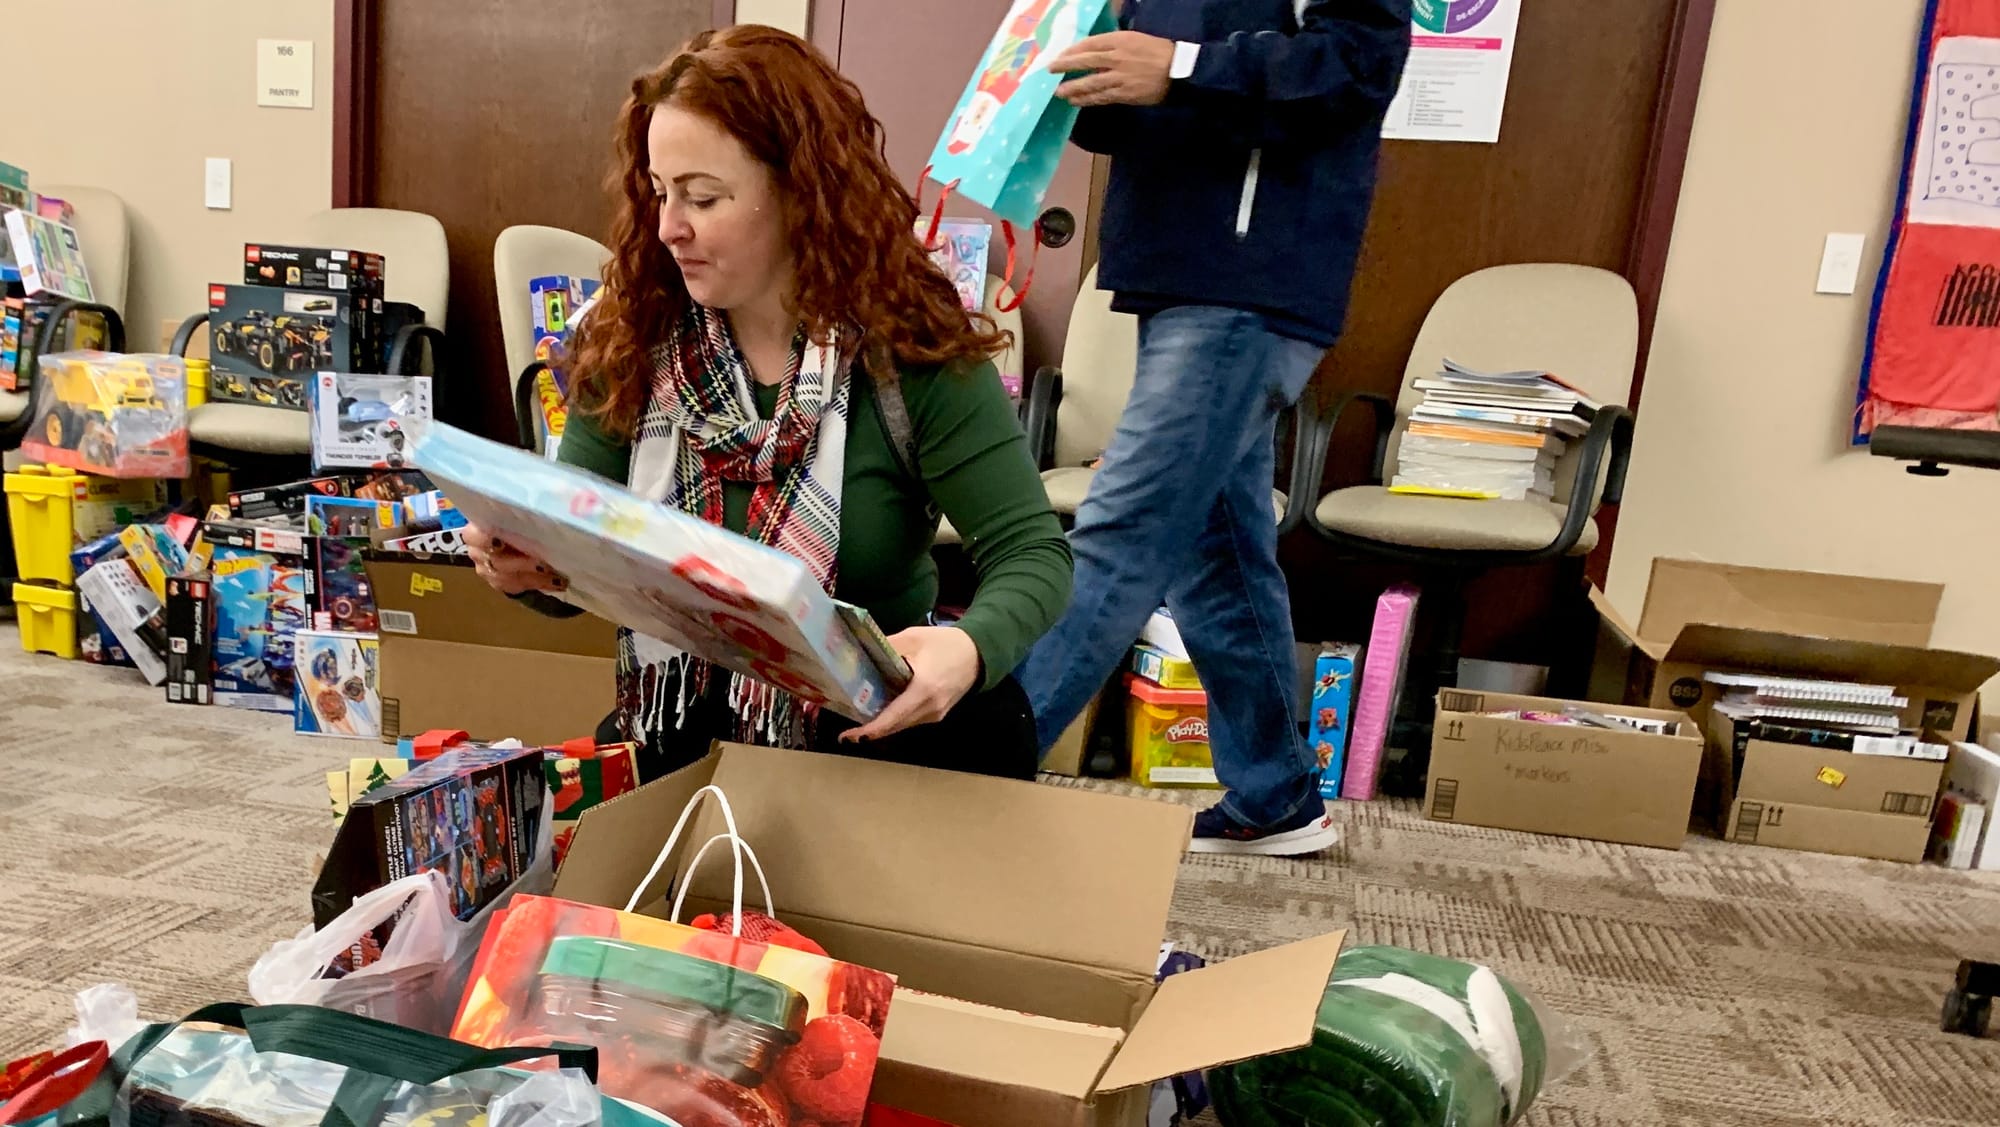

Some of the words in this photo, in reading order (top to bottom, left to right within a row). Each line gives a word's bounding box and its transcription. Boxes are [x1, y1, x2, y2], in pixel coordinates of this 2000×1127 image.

[277, 46, 294, 56] 166
[269, 88, 299, 96] PANTRY
[1168, 722, 1209, 741] Play-Do
[386, 855, 394, 884] ATTLE
